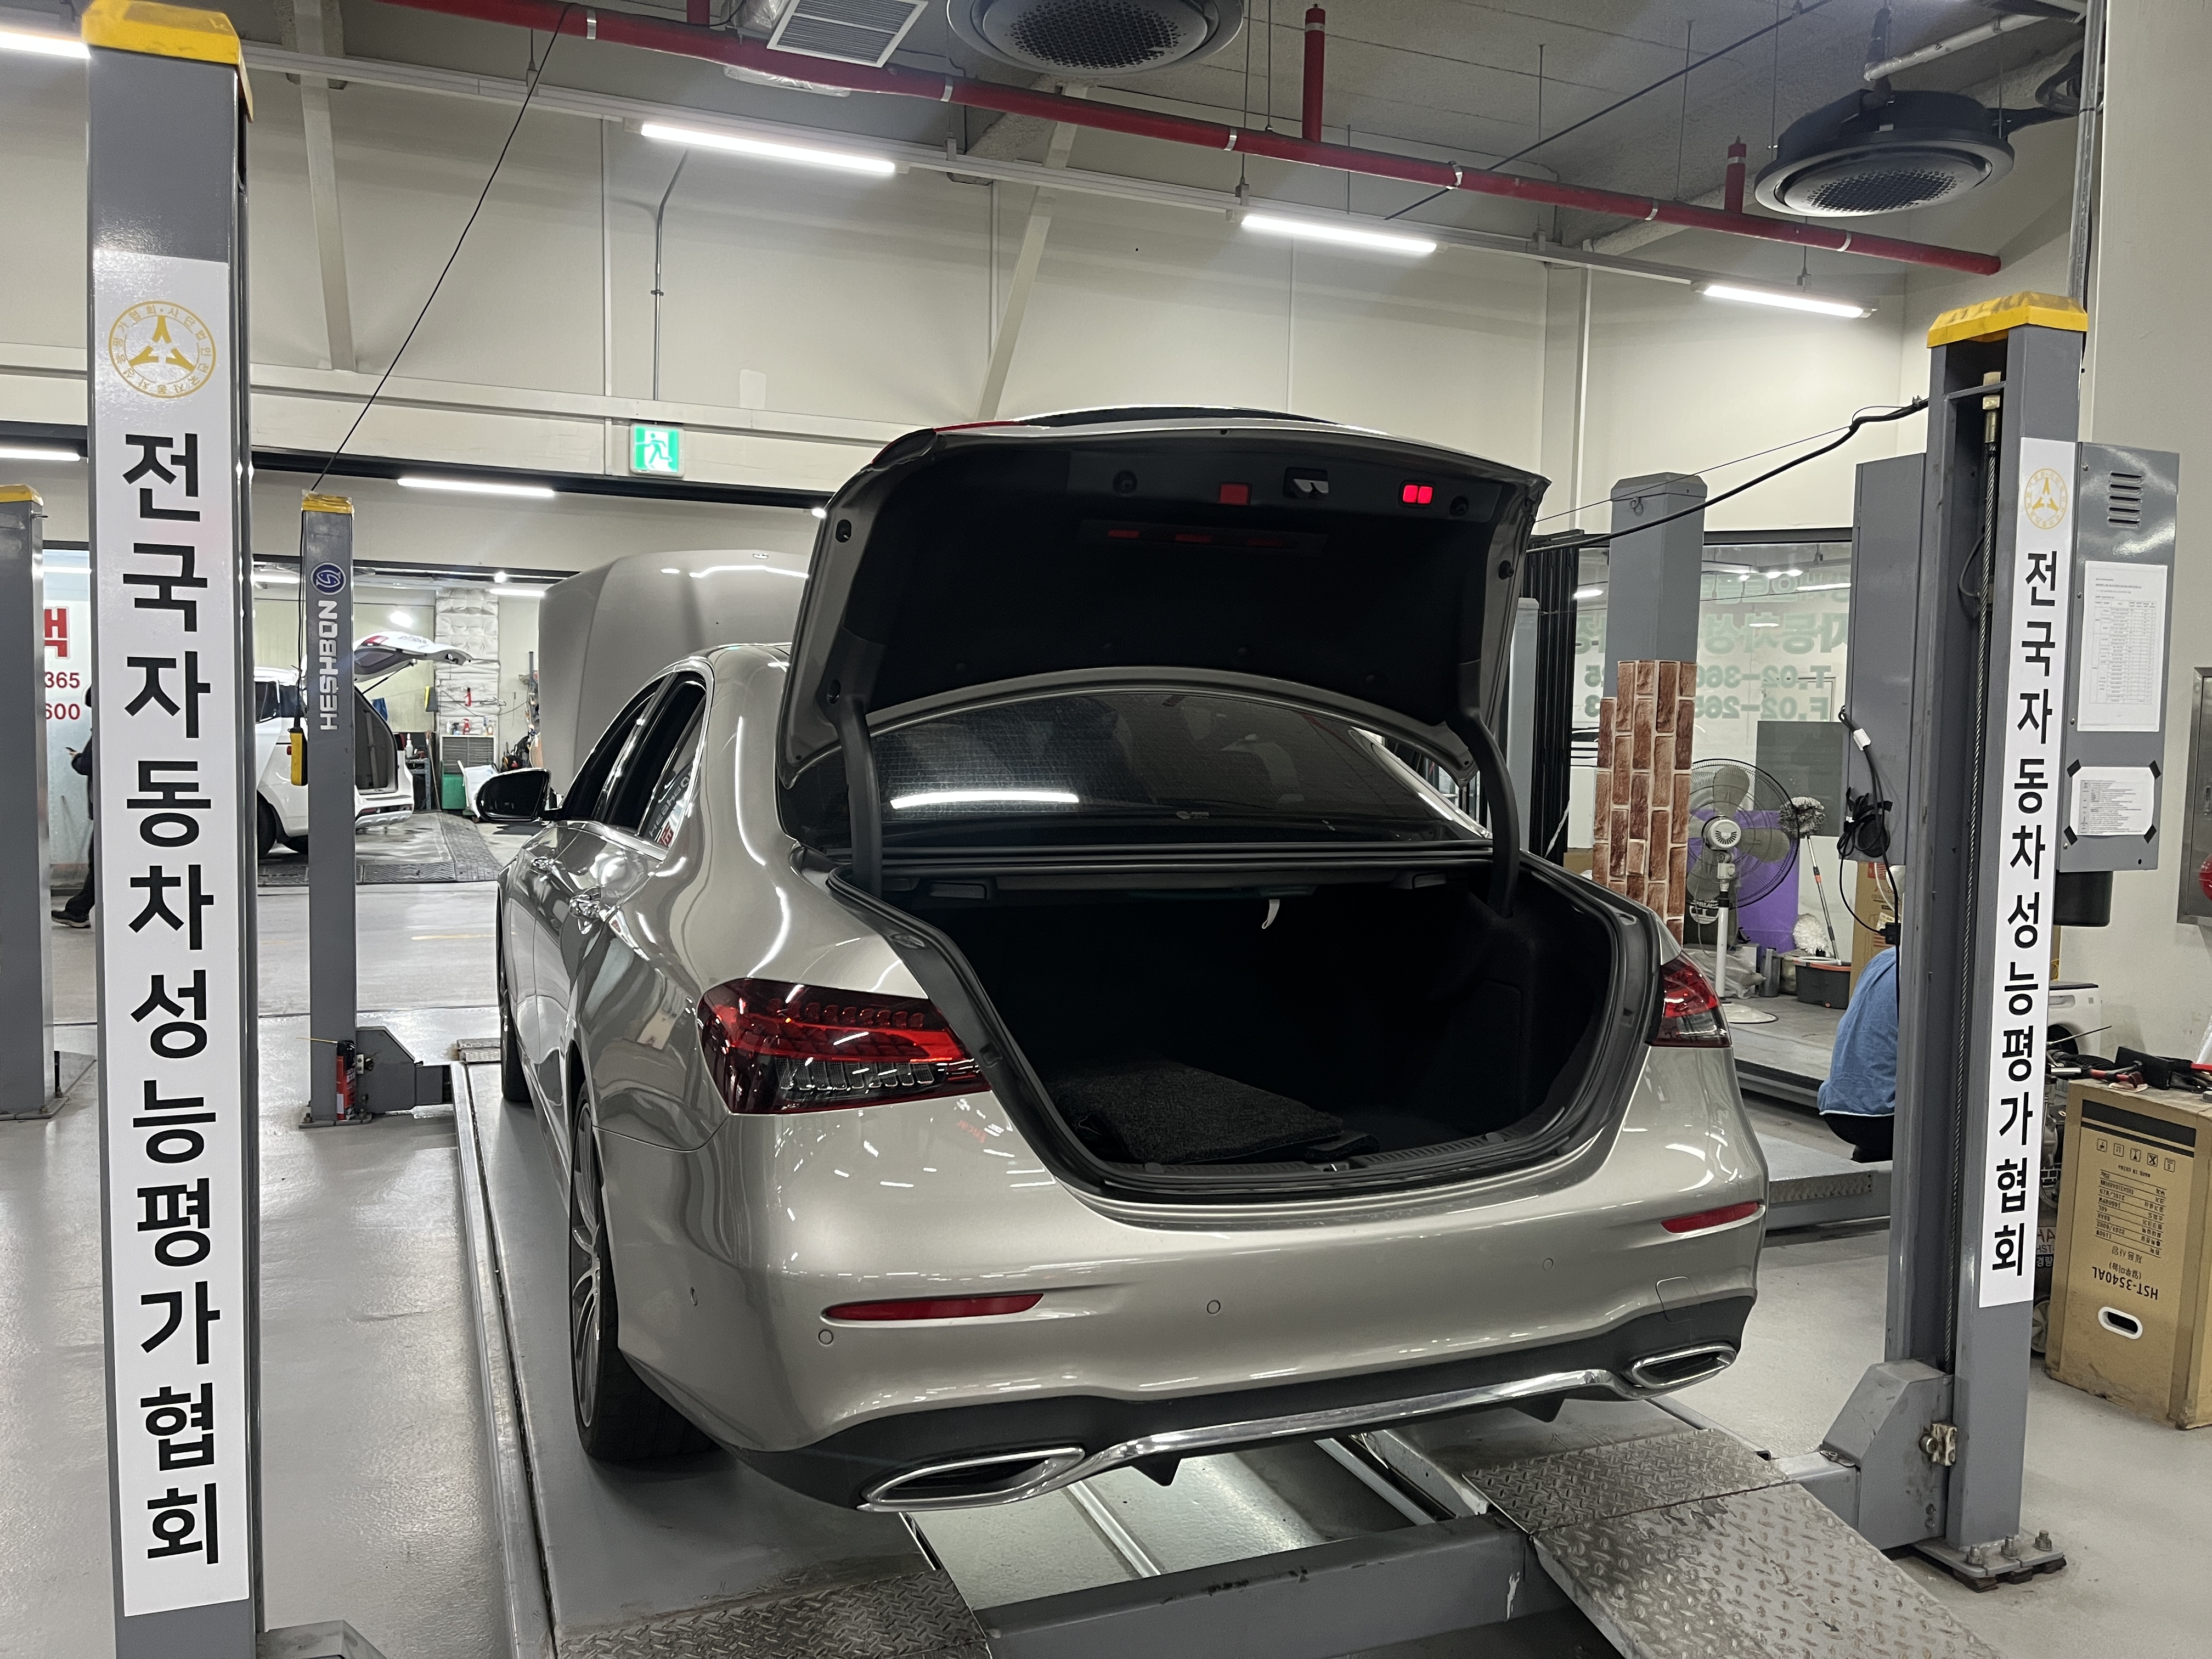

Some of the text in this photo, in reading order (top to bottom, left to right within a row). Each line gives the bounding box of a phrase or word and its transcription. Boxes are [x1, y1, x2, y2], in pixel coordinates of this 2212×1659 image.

[318, 600, 338, 730] HESHBON
[122, 432, 221, 1565] 전국자동차성능평가협회
[1991, 550, 2058, 1277] 전국자동차성능평가협회
[2091, 1266, 2159, 1300] HST-3540AL
